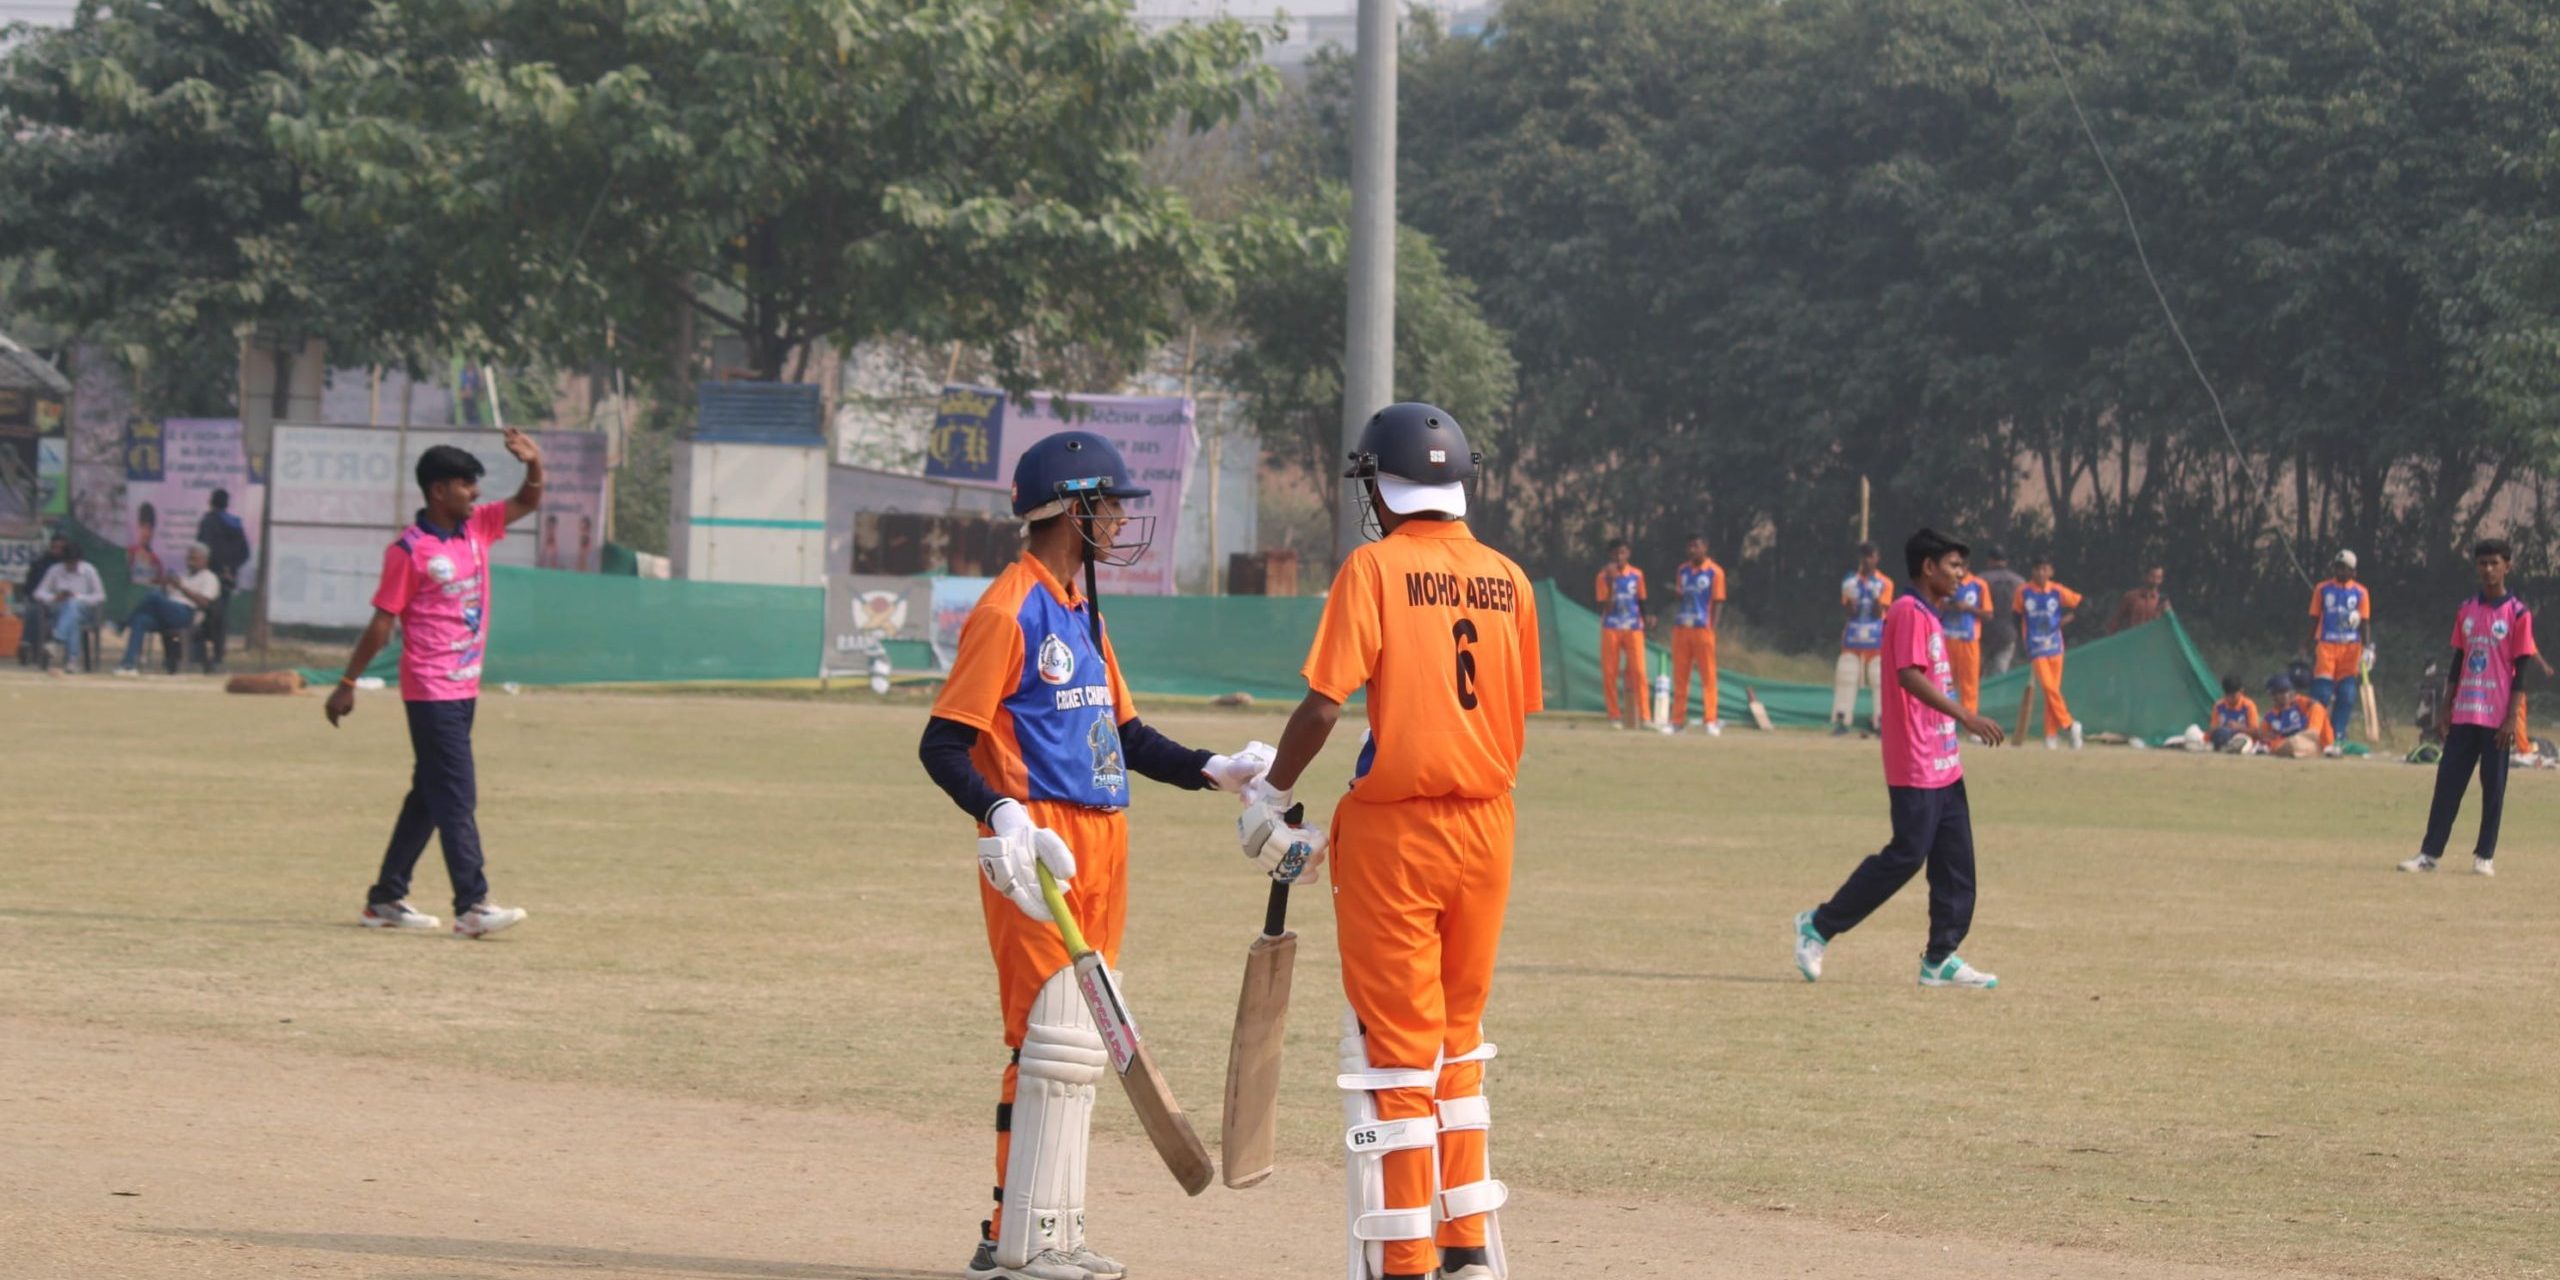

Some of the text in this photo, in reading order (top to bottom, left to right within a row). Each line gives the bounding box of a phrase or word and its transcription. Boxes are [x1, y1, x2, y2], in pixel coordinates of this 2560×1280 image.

[1405, 571, 1513, 613] MOHD ABEER
[1452, 618, 1478, 711] 6
[1056, 687, 1085, 711] CRICKET
[1354, 1130, 1377, 1146] CS
